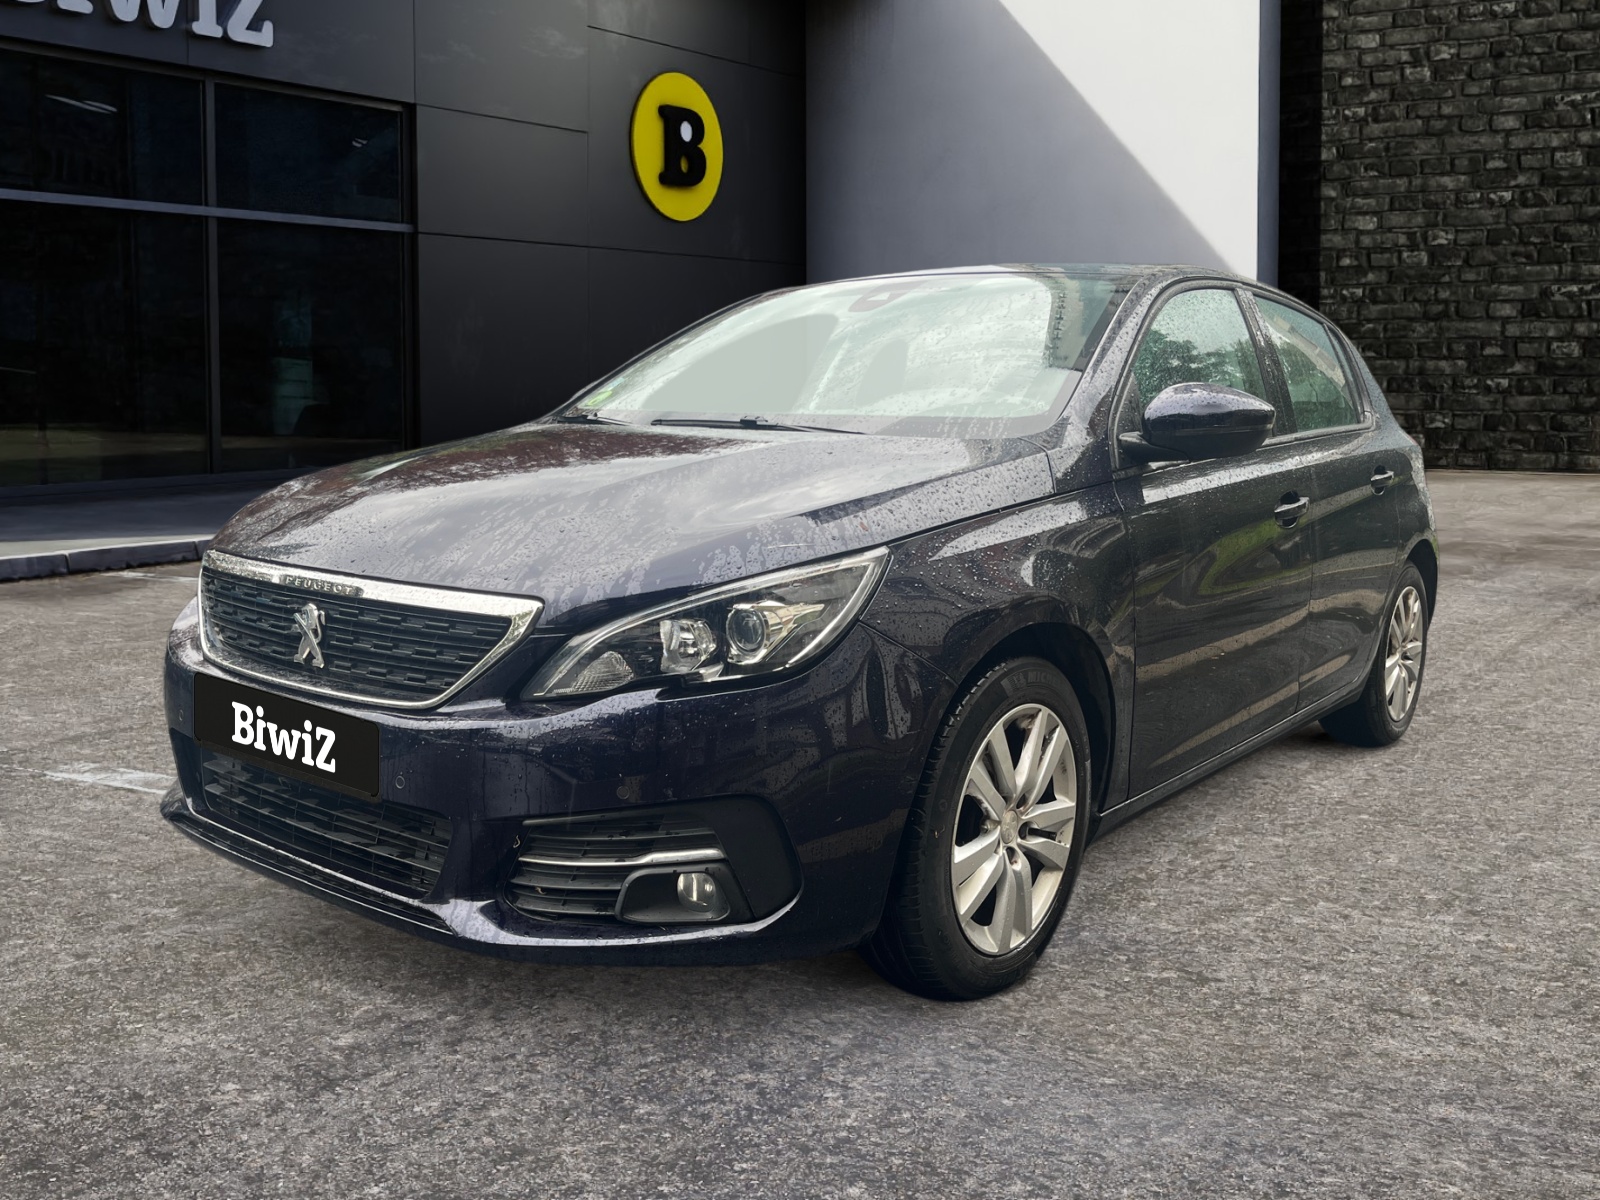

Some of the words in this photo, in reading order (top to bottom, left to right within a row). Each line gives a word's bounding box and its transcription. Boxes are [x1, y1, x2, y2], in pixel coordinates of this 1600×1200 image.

[658, 104, 707, 187] B
[285, 576, 352, 595] PEUGEOT
[231, 701, 336, 773] BiwiZ
